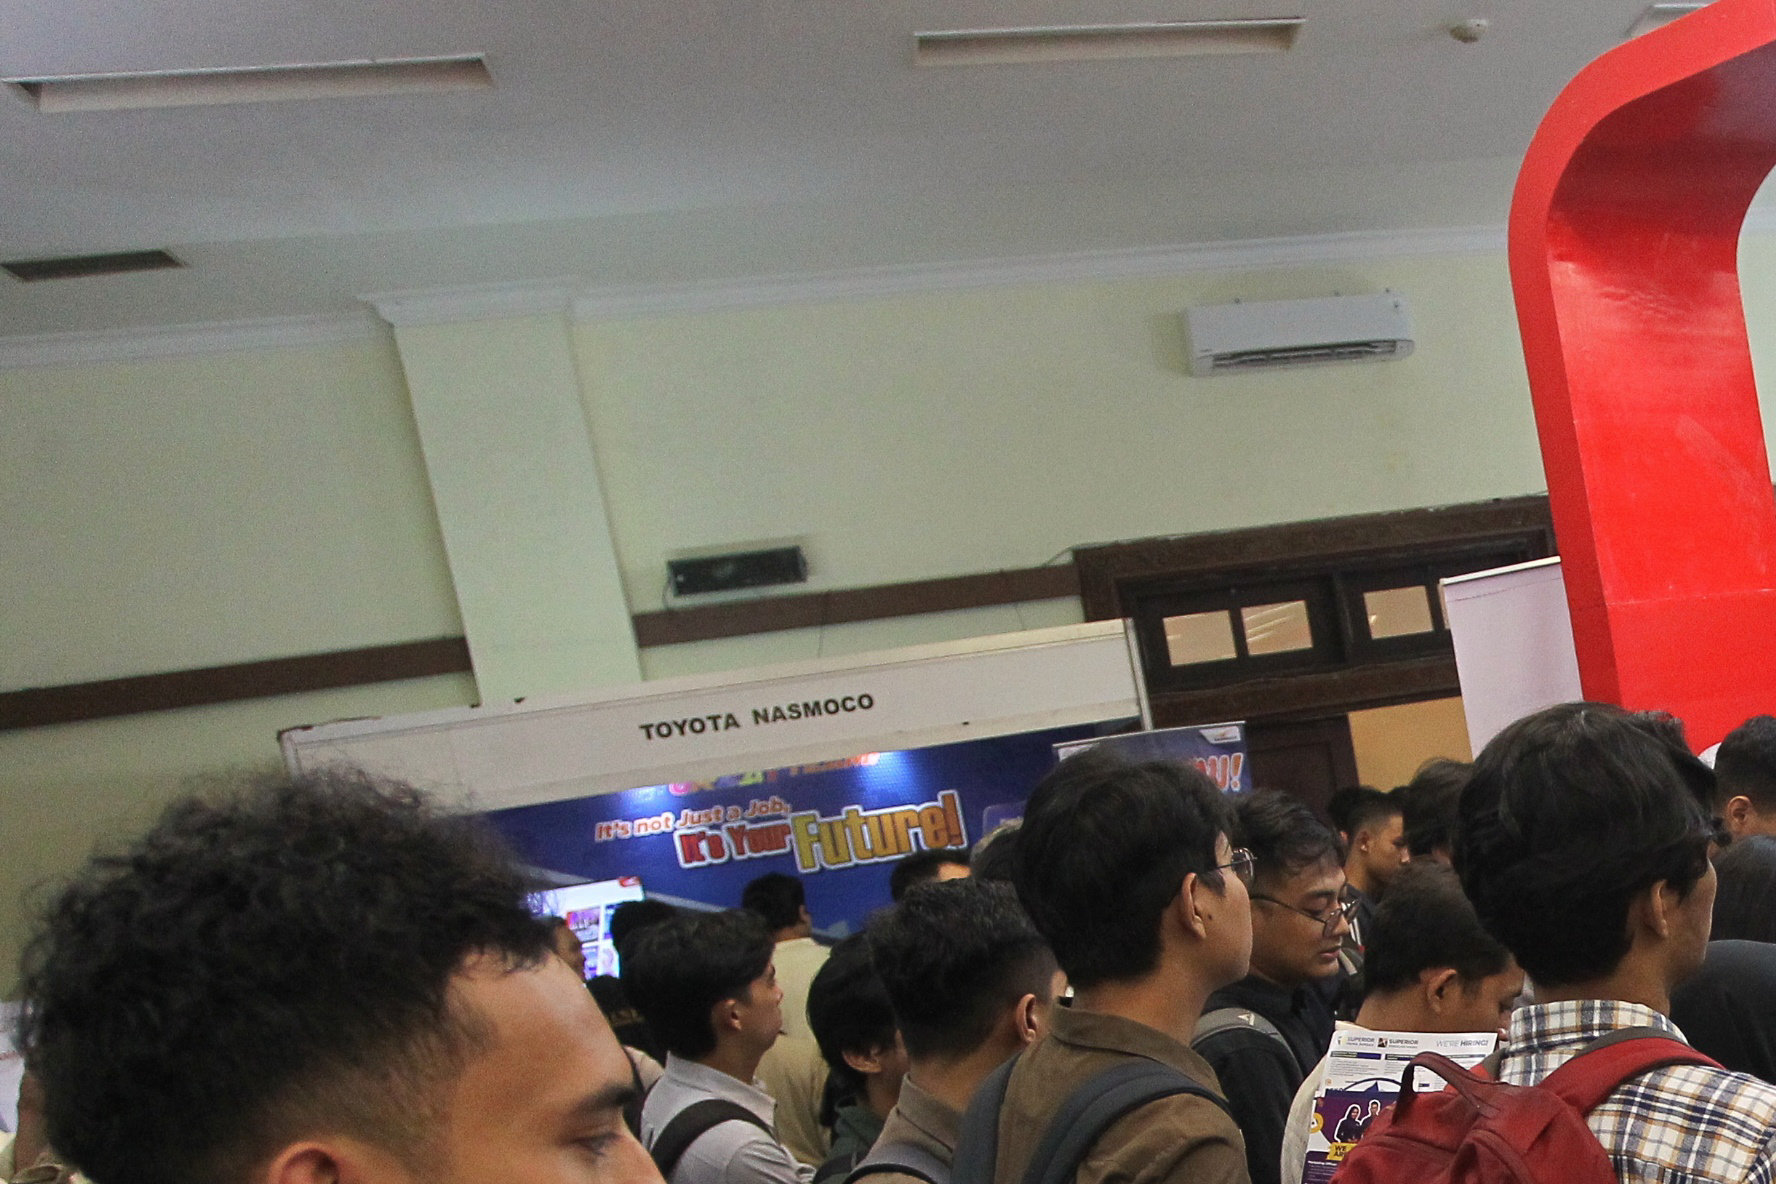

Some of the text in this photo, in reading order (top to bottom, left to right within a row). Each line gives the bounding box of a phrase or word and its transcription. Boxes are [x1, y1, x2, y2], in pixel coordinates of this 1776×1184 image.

[639, 693, 875, 740] TOYOTA NASMOCO
[596, 821, 632, 841] It's
[635, 812, 674, 836] not
[676, 805, 724, 828] Just
[727, 806, 742, 820] a
[724, 821, 793, 858] Your
[791, 791, 966, 870] Future!
